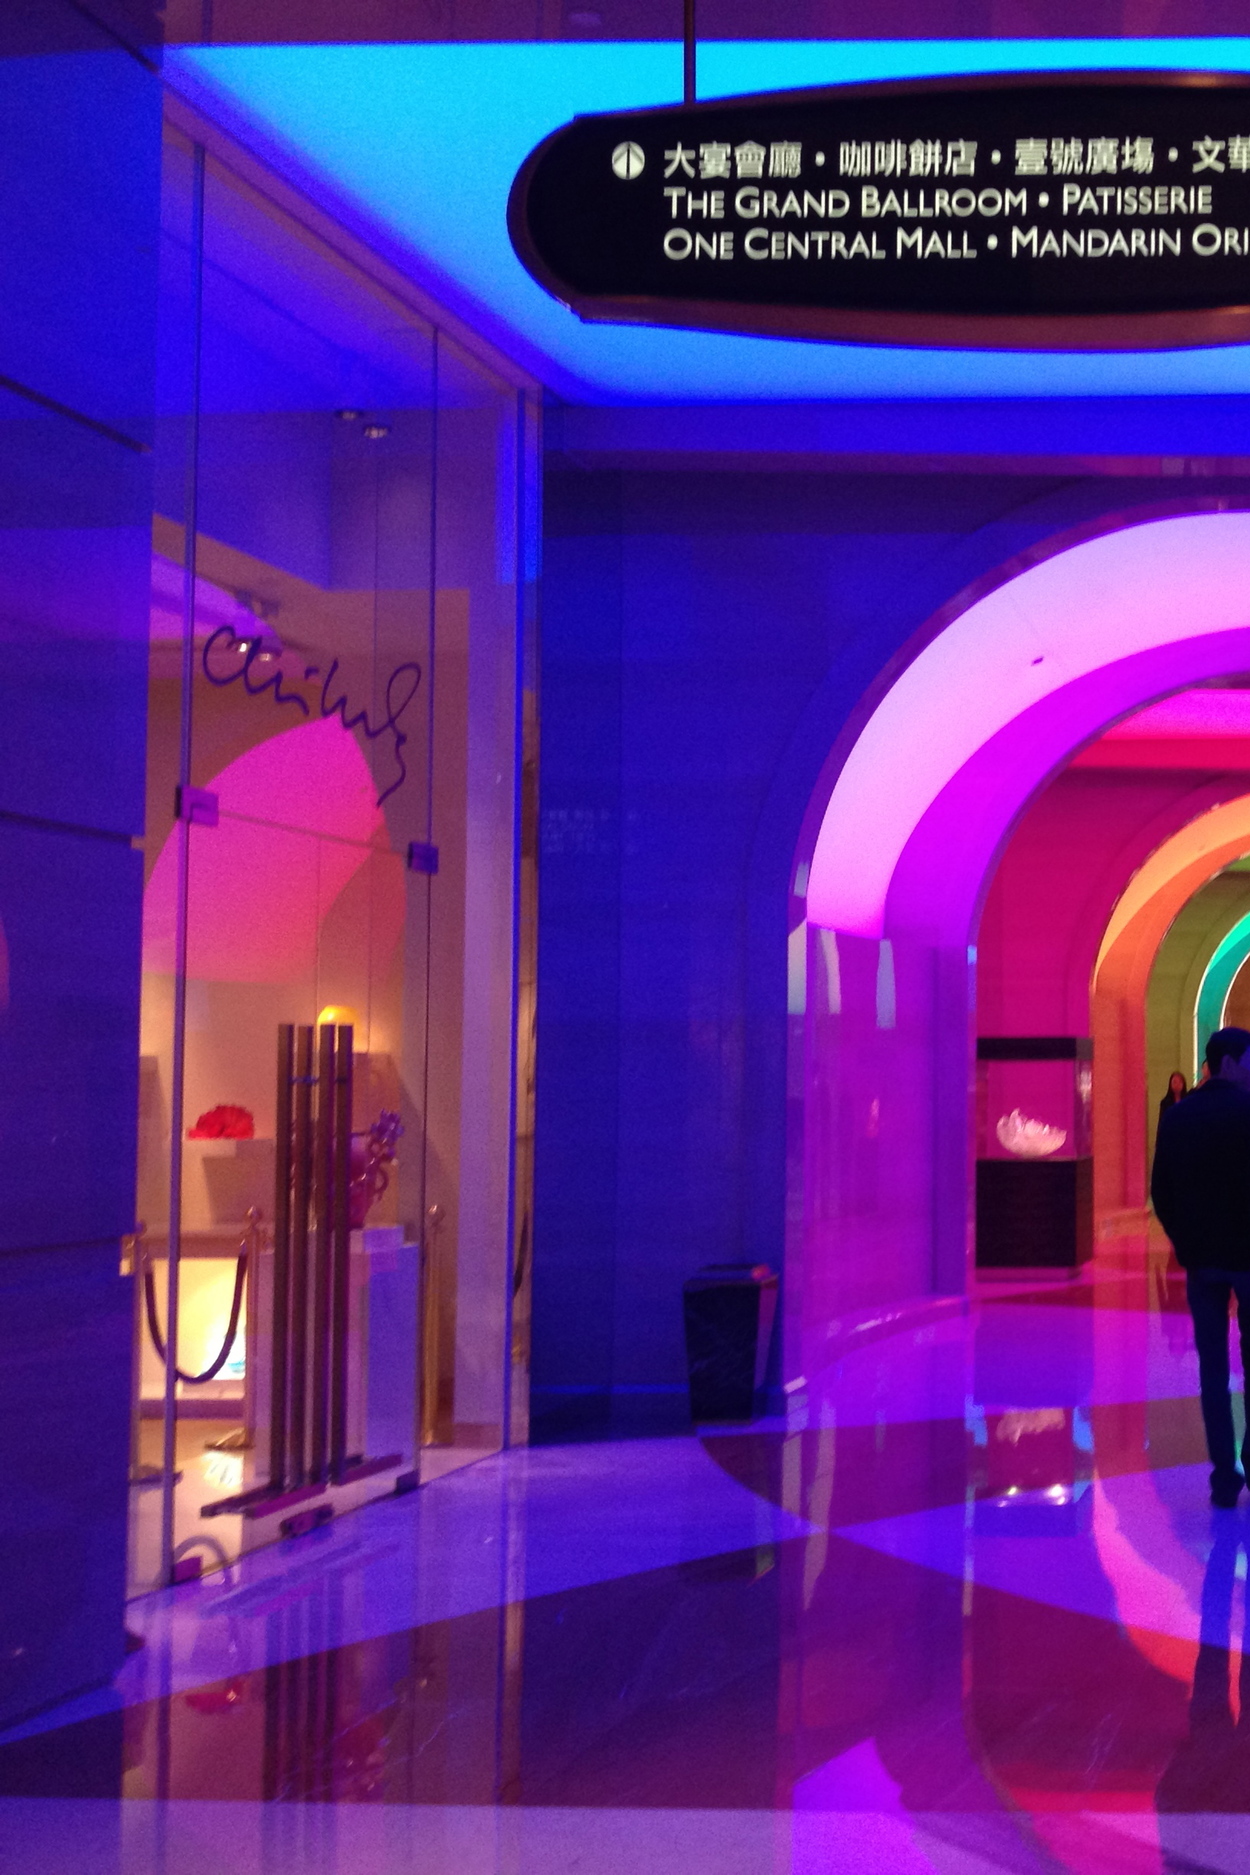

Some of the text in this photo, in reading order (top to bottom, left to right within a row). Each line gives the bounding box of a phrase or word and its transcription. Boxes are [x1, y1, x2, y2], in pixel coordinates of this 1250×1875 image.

[665, 141, 802, 179] 大宴會廳
[840, 138, 978, 178] 咖啡餅店
[664, 183, 1213, 219] THE GRAND BALLROOM PATISSERIE
[664, 228, 734, 260] ONE
[745, 228, 886, 260] CENTRAL
[897, 227, 978, 259] MALL
[1012, 225, 1182, 258] MANDARIN
